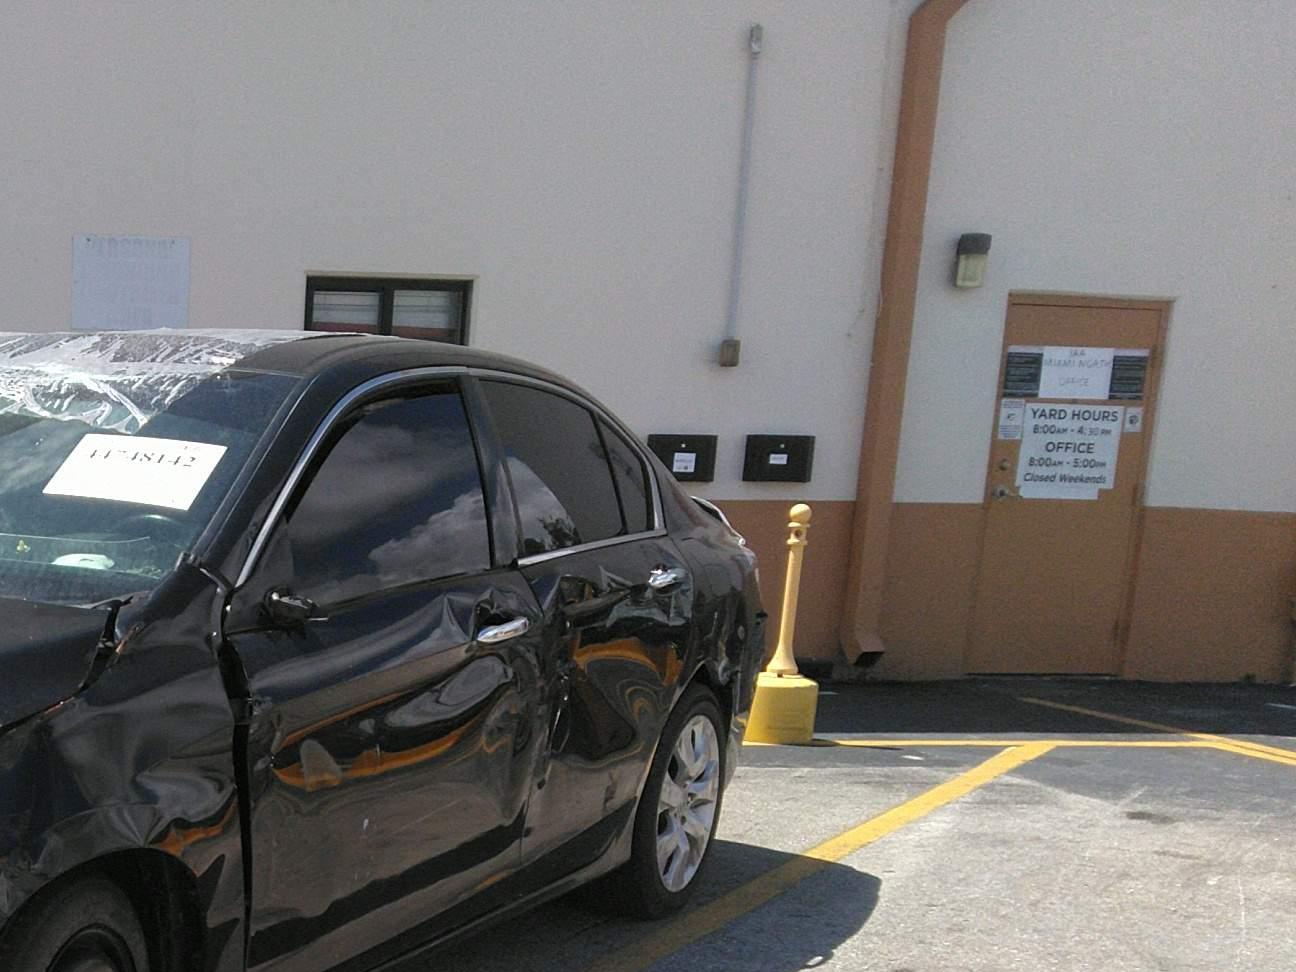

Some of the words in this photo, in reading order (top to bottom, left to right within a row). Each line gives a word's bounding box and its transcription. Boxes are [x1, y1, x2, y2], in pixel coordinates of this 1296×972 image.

[1031, 408, 1067, 421] YARD
[1072, 409, 1119, 422] HOURS
[1033, 424, 1067, 434] 8:00AM
[1045, 441, 1095, 454] OFFICE
[1028, 457, 1063, 467] 8:00AM
[1024, 472, 1056, 482] Closed
[1059, 473, 1106, 484] Weekends
